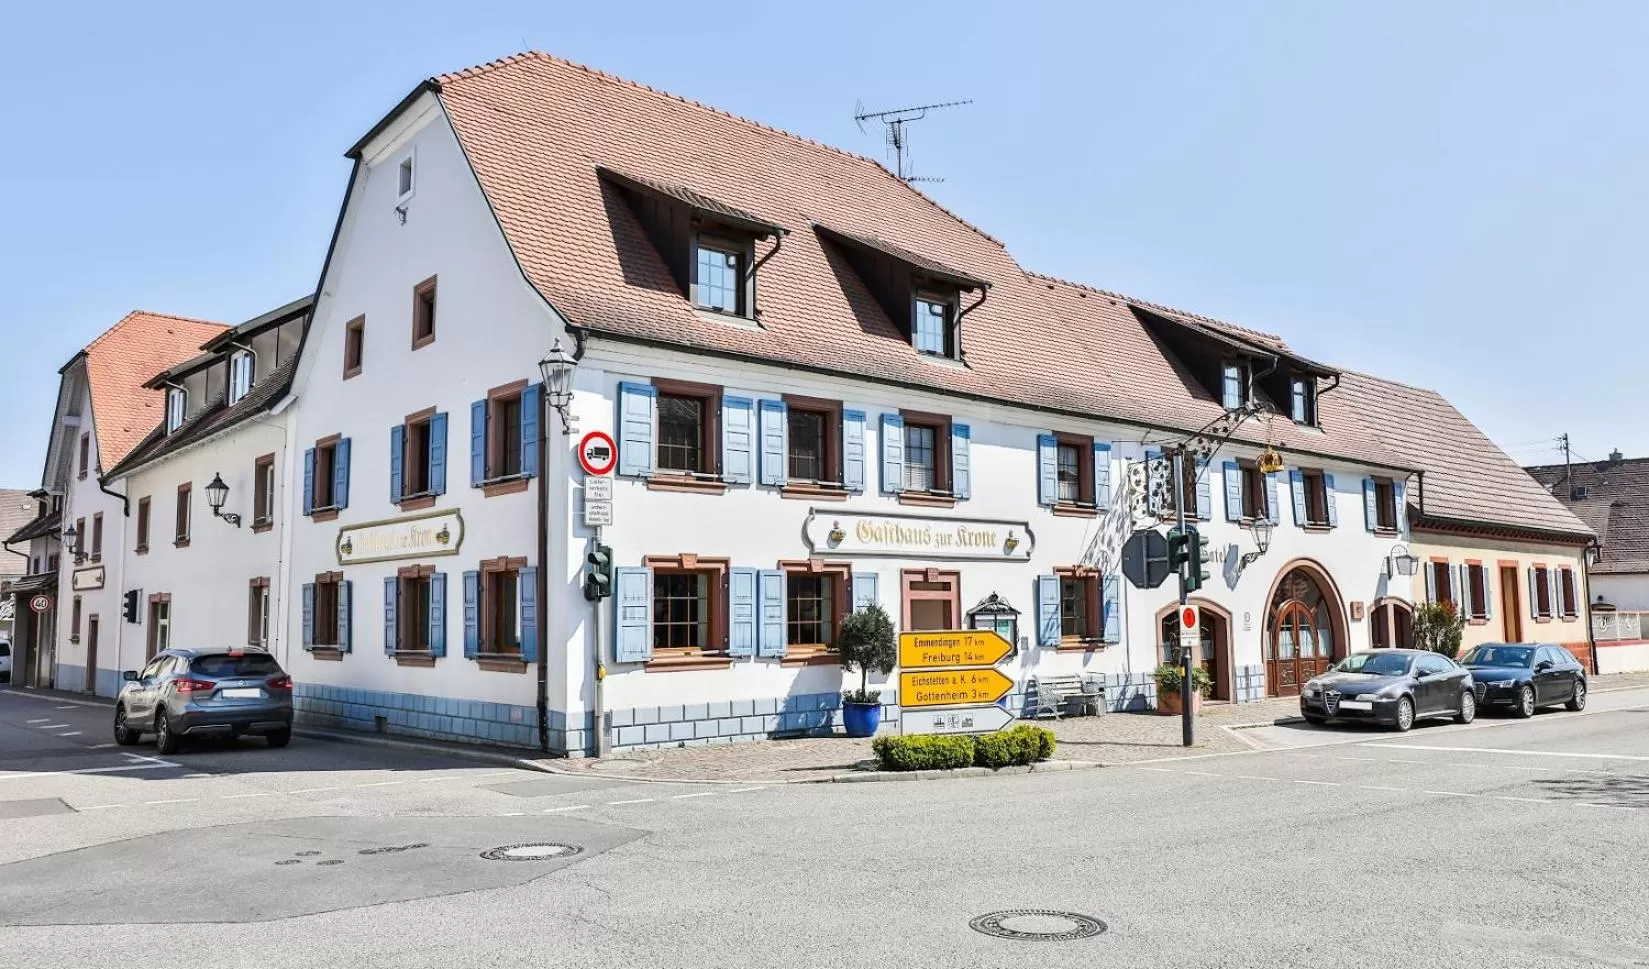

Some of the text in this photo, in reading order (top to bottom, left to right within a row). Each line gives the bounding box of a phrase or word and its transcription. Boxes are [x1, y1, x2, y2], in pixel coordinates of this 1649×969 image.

[934, 533, 952, 548] zur
[956, 524, 997, 548] Krone
[35, 599, 47, 608] 40
[914, 635, 985, 649] Emmendingen 17 km
[922, 652, 961, 664] Freiburg
[964, 651, 973, 661] 14
[912, 675, 949, 687] Eichstetten
[971, 673, 977, 684] 6
[916, 689, 989, 702] Gottenheim 3 km
